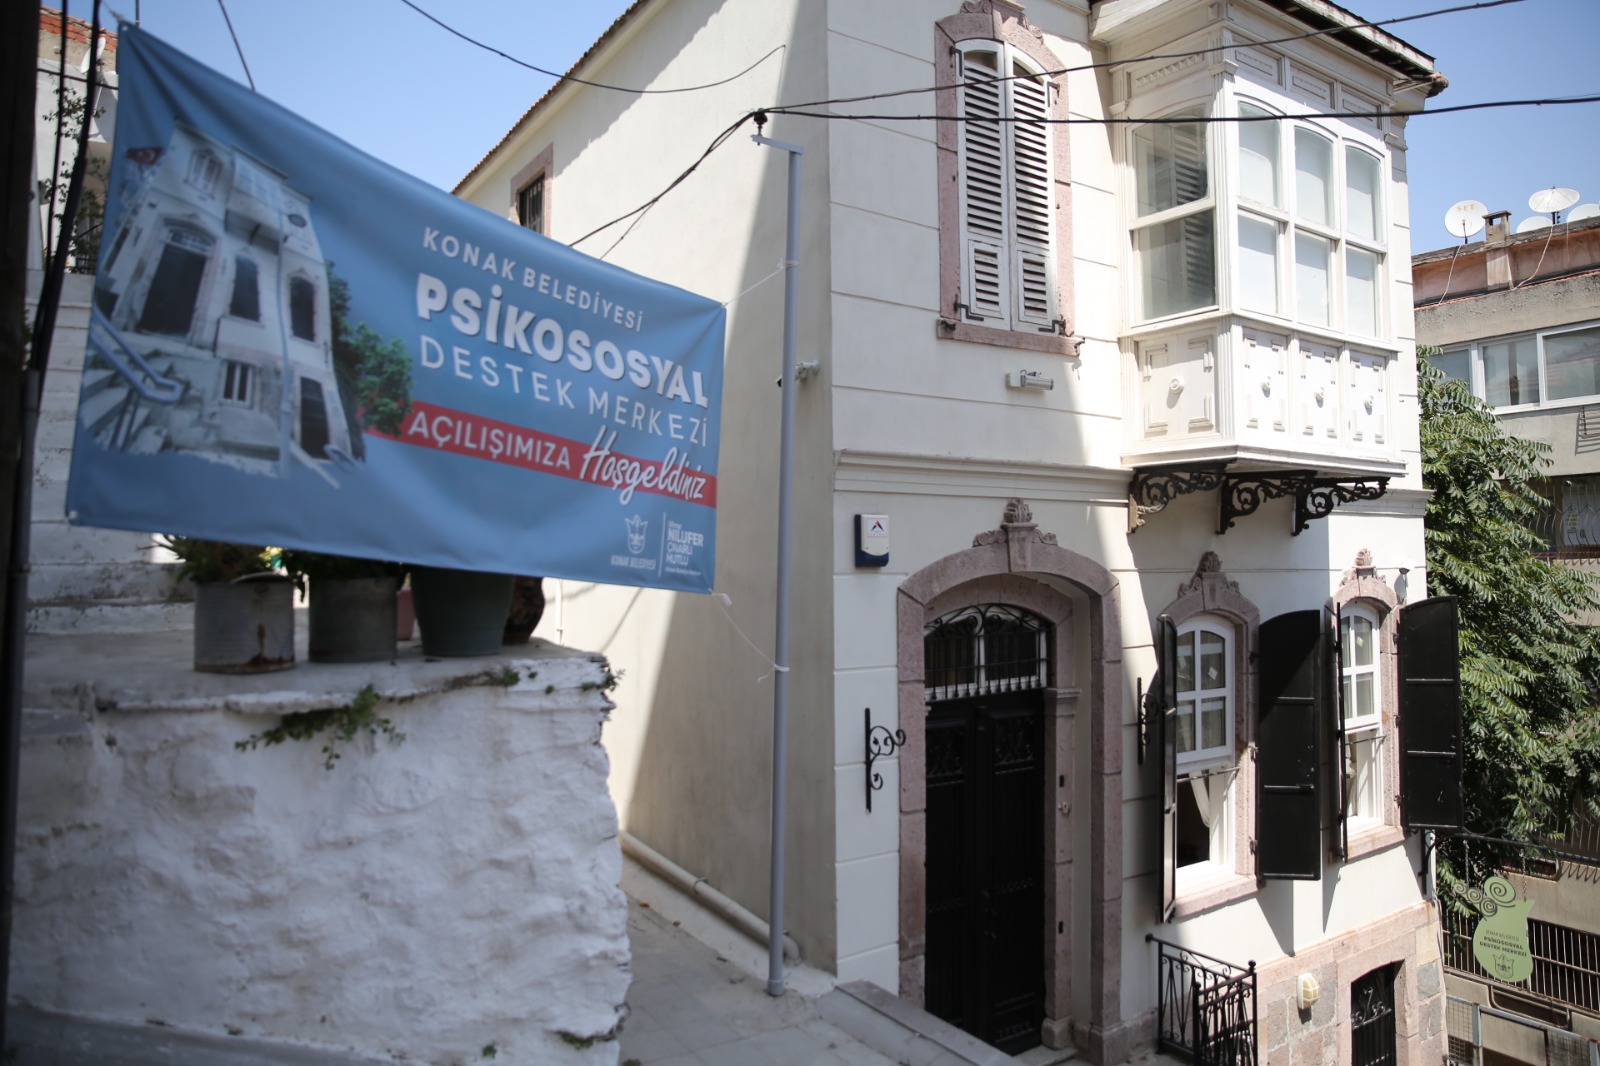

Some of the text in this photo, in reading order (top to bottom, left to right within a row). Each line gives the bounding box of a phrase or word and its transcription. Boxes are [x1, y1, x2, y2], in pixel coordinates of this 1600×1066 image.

[423, 226, 644, 332] KONAK BELEDİYESİ
[416, 272, 709, 409] PSİKOSOSYAL
[420, 334, 707, 447] DESTEK MERKEZİ
[407, 411, 706, 506] AÇILIŞIMIZA Hoşgeldiniz
[1480, 941, 1501, 951] DESTEK
